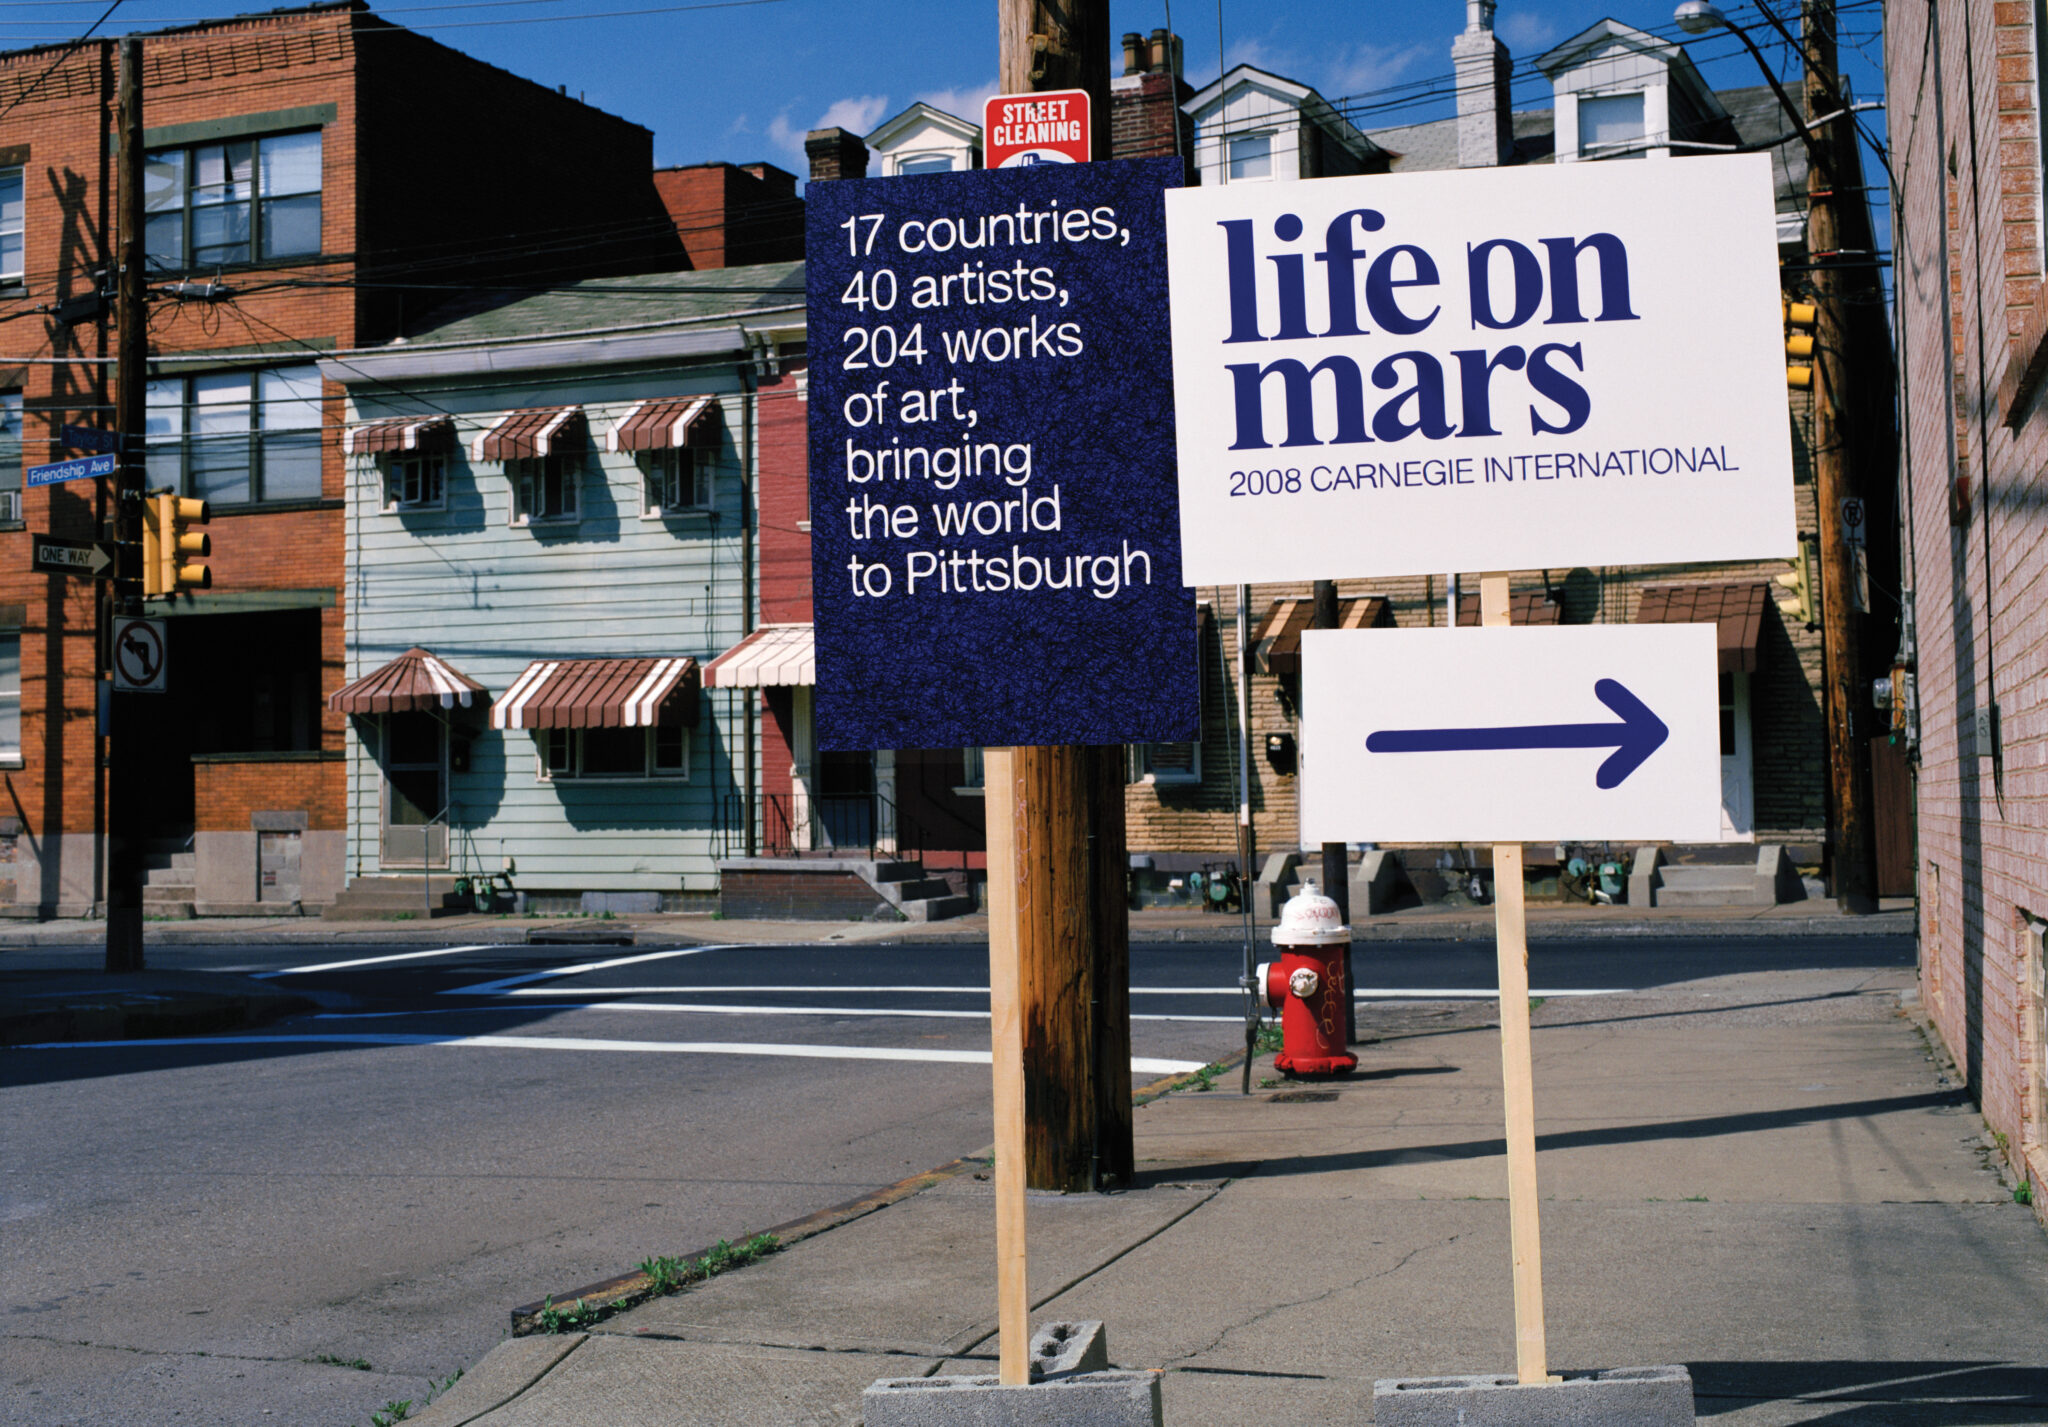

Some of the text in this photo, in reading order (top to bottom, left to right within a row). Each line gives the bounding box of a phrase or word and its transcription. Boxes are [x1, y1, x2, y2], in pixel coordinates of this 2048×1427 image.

[993, 120, 1081, 146] CLEANING
[1003, 100, 1069, 124] STREET
[841, 200, 1130, 257] 17 countries,
[841, 259, 1070, 312] 40 artists,
[1216, 208, 1641, 345] life on
[842, 314, 1084, 371] 204 works
[843, 377, 978, 428] of art,
[1223, 341, 1591, 451] mars
[30, 460, 110, 483] Friendship Ave
[846, 436, 1032, 490] bringing
[1229, 445, 1740, 497] 2008 CARNEGIE INTERNATIONAL
[846, 484, 1061, 541] the world
[41, 547, 91, 565] ONE WAY
[847, 539, 1152, 599] to Pittsburgh
